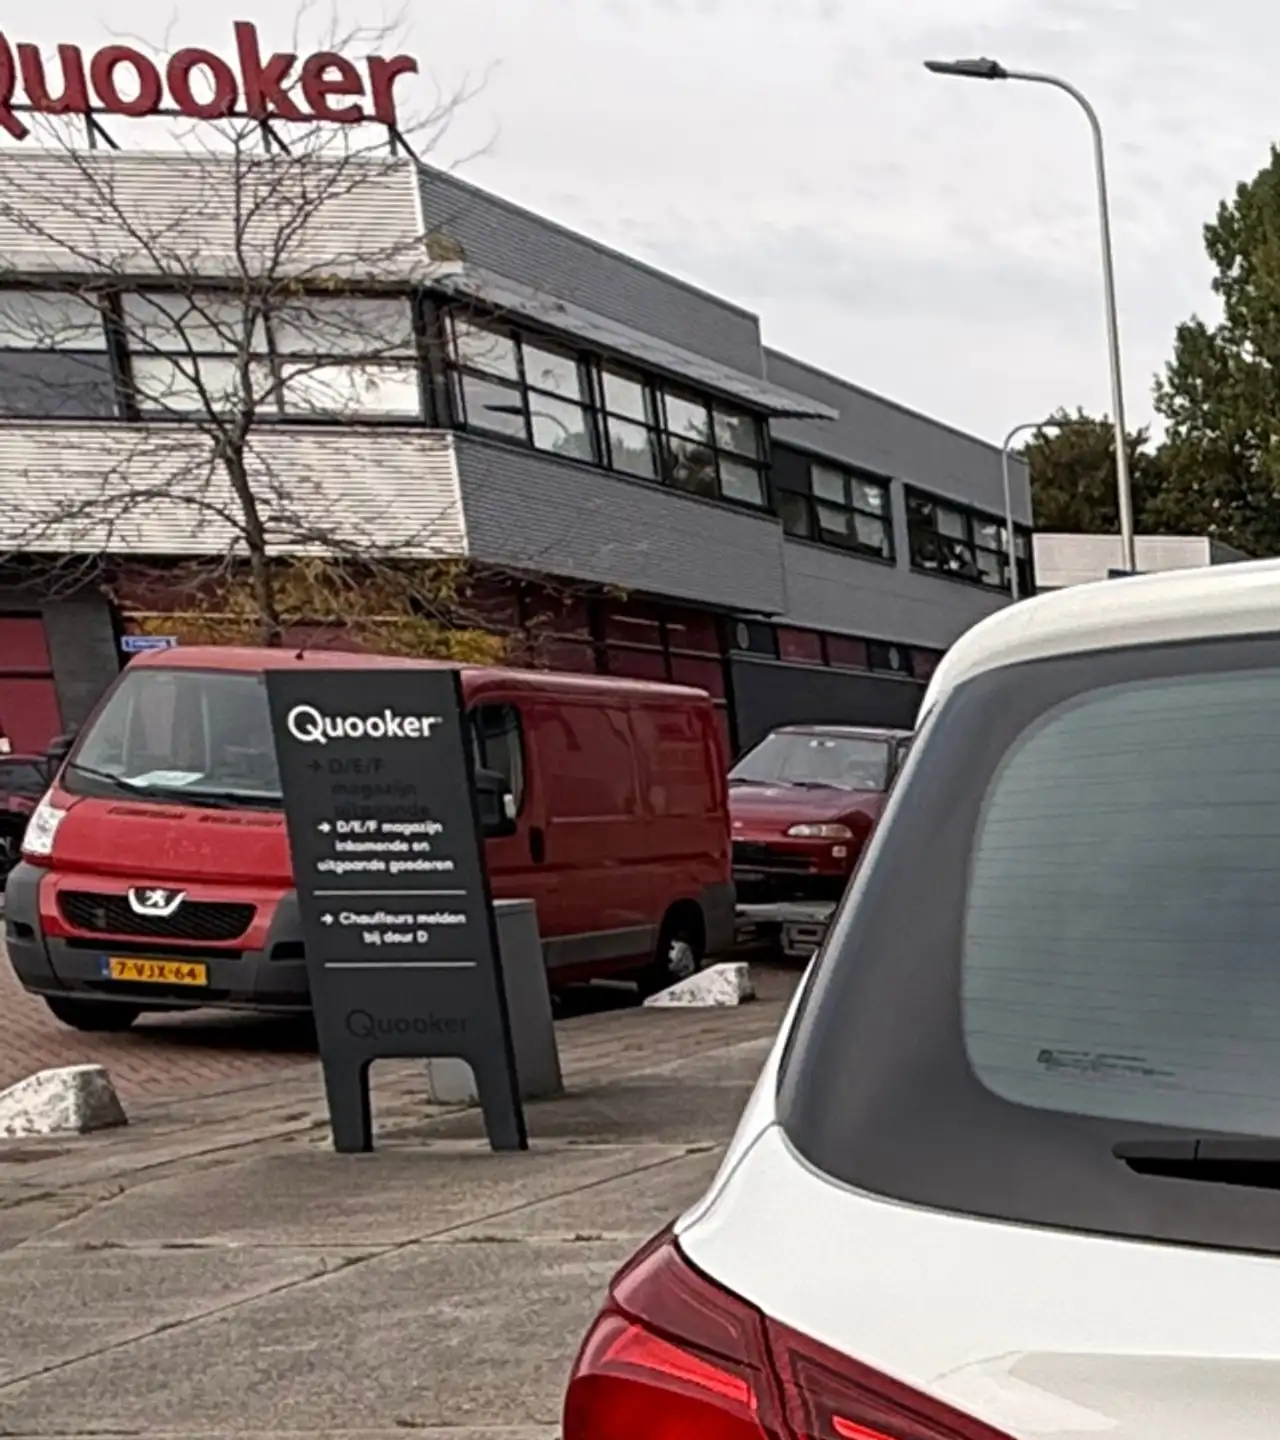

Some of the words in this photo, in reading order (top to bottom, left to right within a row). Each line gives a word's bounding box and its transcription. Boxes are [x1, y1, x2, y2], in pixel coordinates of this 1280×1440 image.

[287, 705, 435, 744] Quooker
[336, 820, 378, 834] D/E/F
[381, 820, 443, 835] magazijn
[412, 841, 431, 852] en
[316, 858, 386, 874] uitgaande
[388, 858, 454, 874] goederen
[339, 911, 414, 925] Chauffeurs
[416, 911, 466, 925] melden
[362, 930, 381, 945] bij
[383, 930, 413, 943] deur
[416, 930, 429, 943] D
[345, 1008, 468, 1041] Quooker
